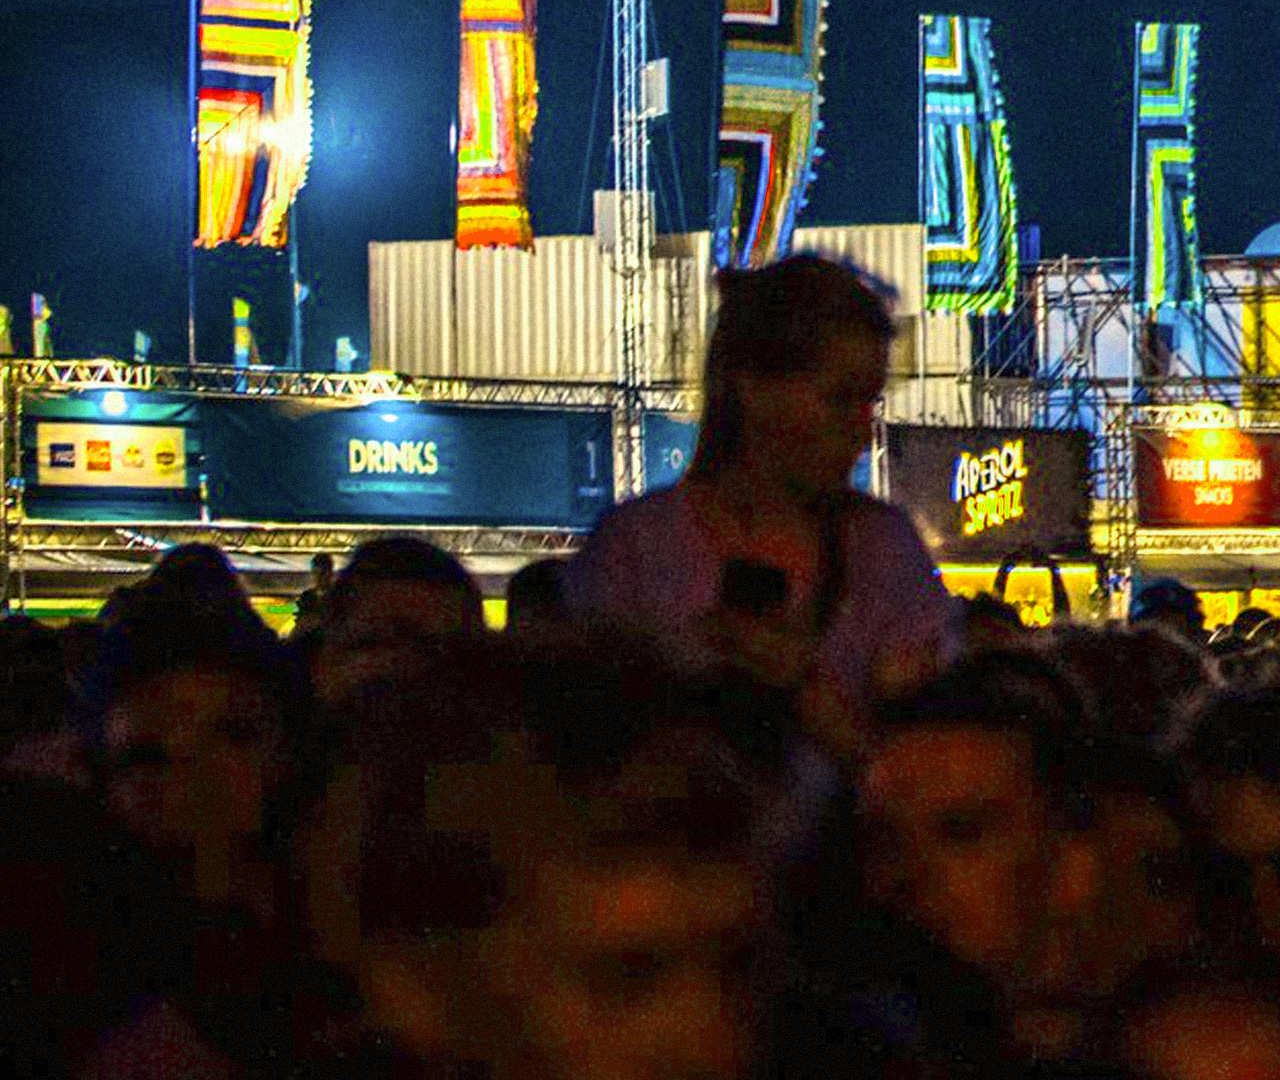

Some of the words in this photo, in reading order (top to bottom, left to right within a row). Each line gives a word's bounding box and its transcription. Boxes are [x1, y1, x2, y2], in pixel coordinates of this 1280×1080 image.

[348, 439, 439, 475] DRINKS
[955, 439, 1028, 502] APEROL
[964, 481, 1023, 535] SPRITZ
